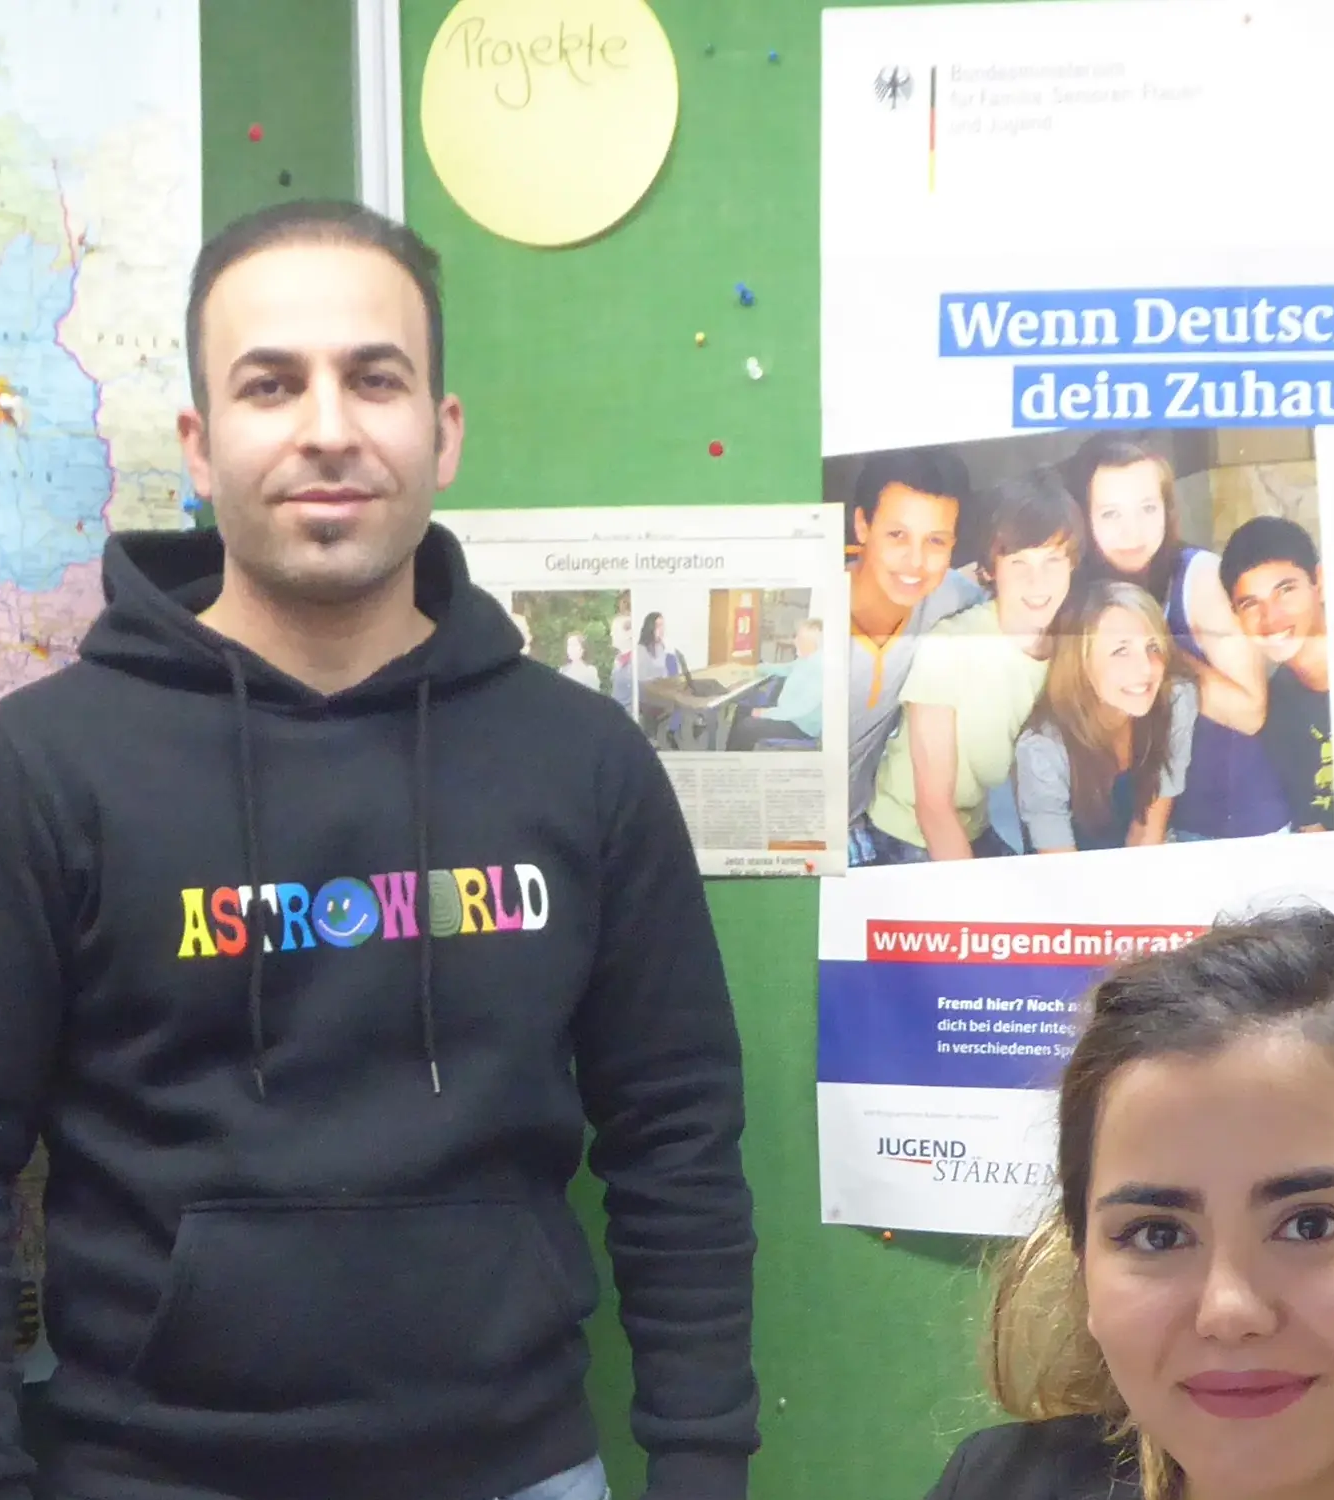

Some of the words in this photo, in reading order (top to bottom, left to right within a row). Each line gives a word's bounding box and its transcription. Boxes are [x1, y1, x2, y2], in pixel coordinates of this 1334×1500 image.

[445, 16, 629, 111] Projekte
[946, 299, 1121, 350] Wenn
[1019, 369, 1153, 421] dein
[544, 553, 630, 576] Gelungene
[634, 552, 725, 575] Integration
[177, 863, 549, 959] ASTROWORLD
[937, 996, 984, 1011] Fremd
[986, 997, 1023, 1012] hier?
[1027, 998, 1064, 1013] Noch
[937, 1018, 967, 1032] dich
[969, 1019, 991, 1033] bei
[993, 1019, 1037, 1034] deiner
[937, 1040, 951, 1053] in
[952, 1041, 1051, 1056] verschiedenen
[876, 1137, 967, 1159] JUGEND
